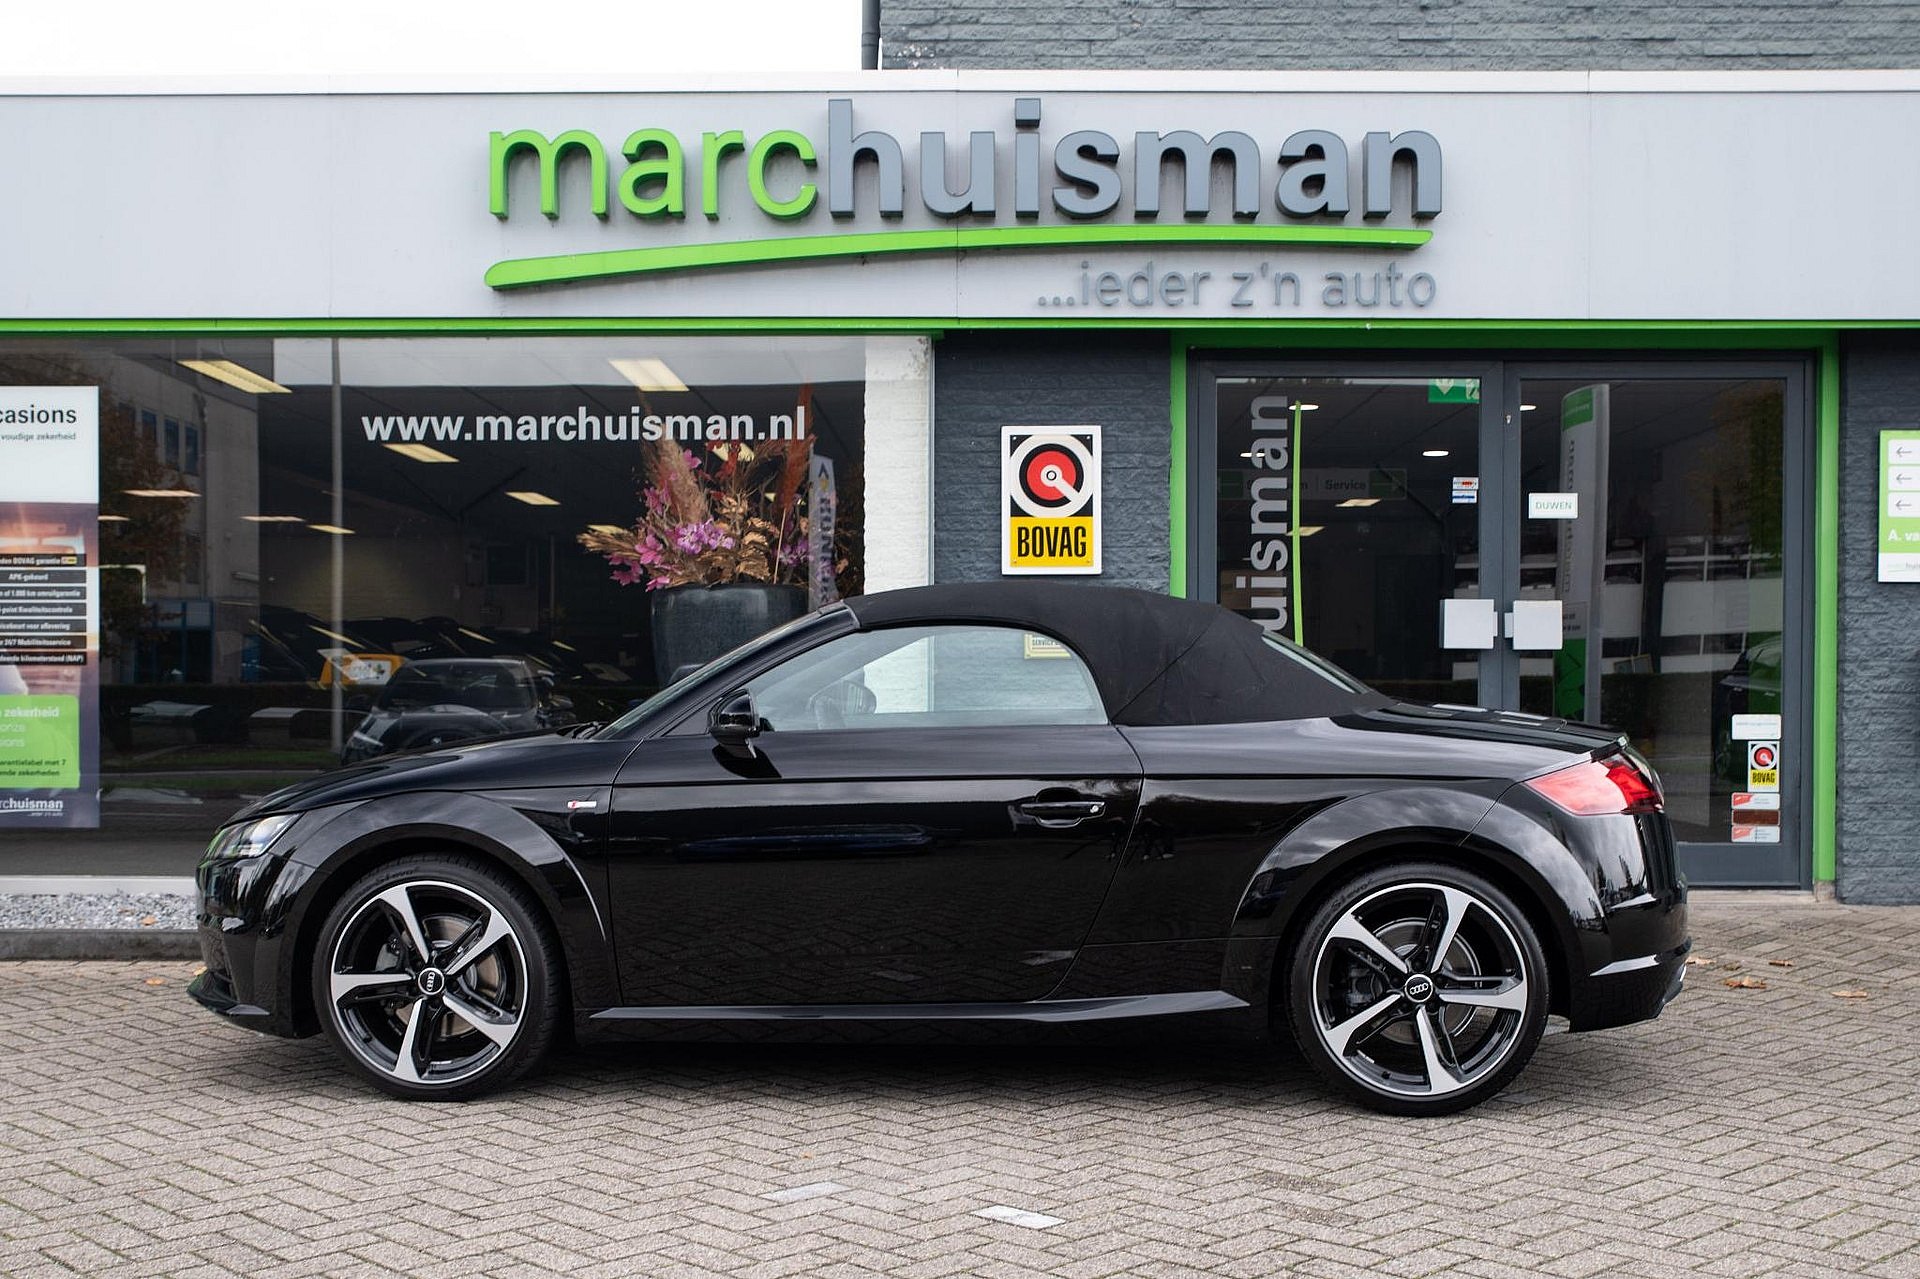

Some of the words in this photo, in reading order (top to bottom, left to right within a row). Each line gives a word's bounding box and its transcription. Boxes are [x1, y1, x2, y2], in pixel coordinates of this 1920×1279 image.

[490, 98, 1443, 220] marchuisman
[1038, 260, 1211, 307] ...ieder
[1231, 261, 1301, 307] z'n
[1321, 261, 1437, 307] auto
[361, 405, 806, 441] www.marchuisman.nl
[37, 432, 76, 440] zekerheid
[1324, 479, 1367, 490] Service
[1535, 502, 1573, 510] DUWEN
[1017, 525, 1087, 558] BOVAG
[4, 706, 60, 718] zekerheid
[1752, 772, 1776, 784] BOVAG
